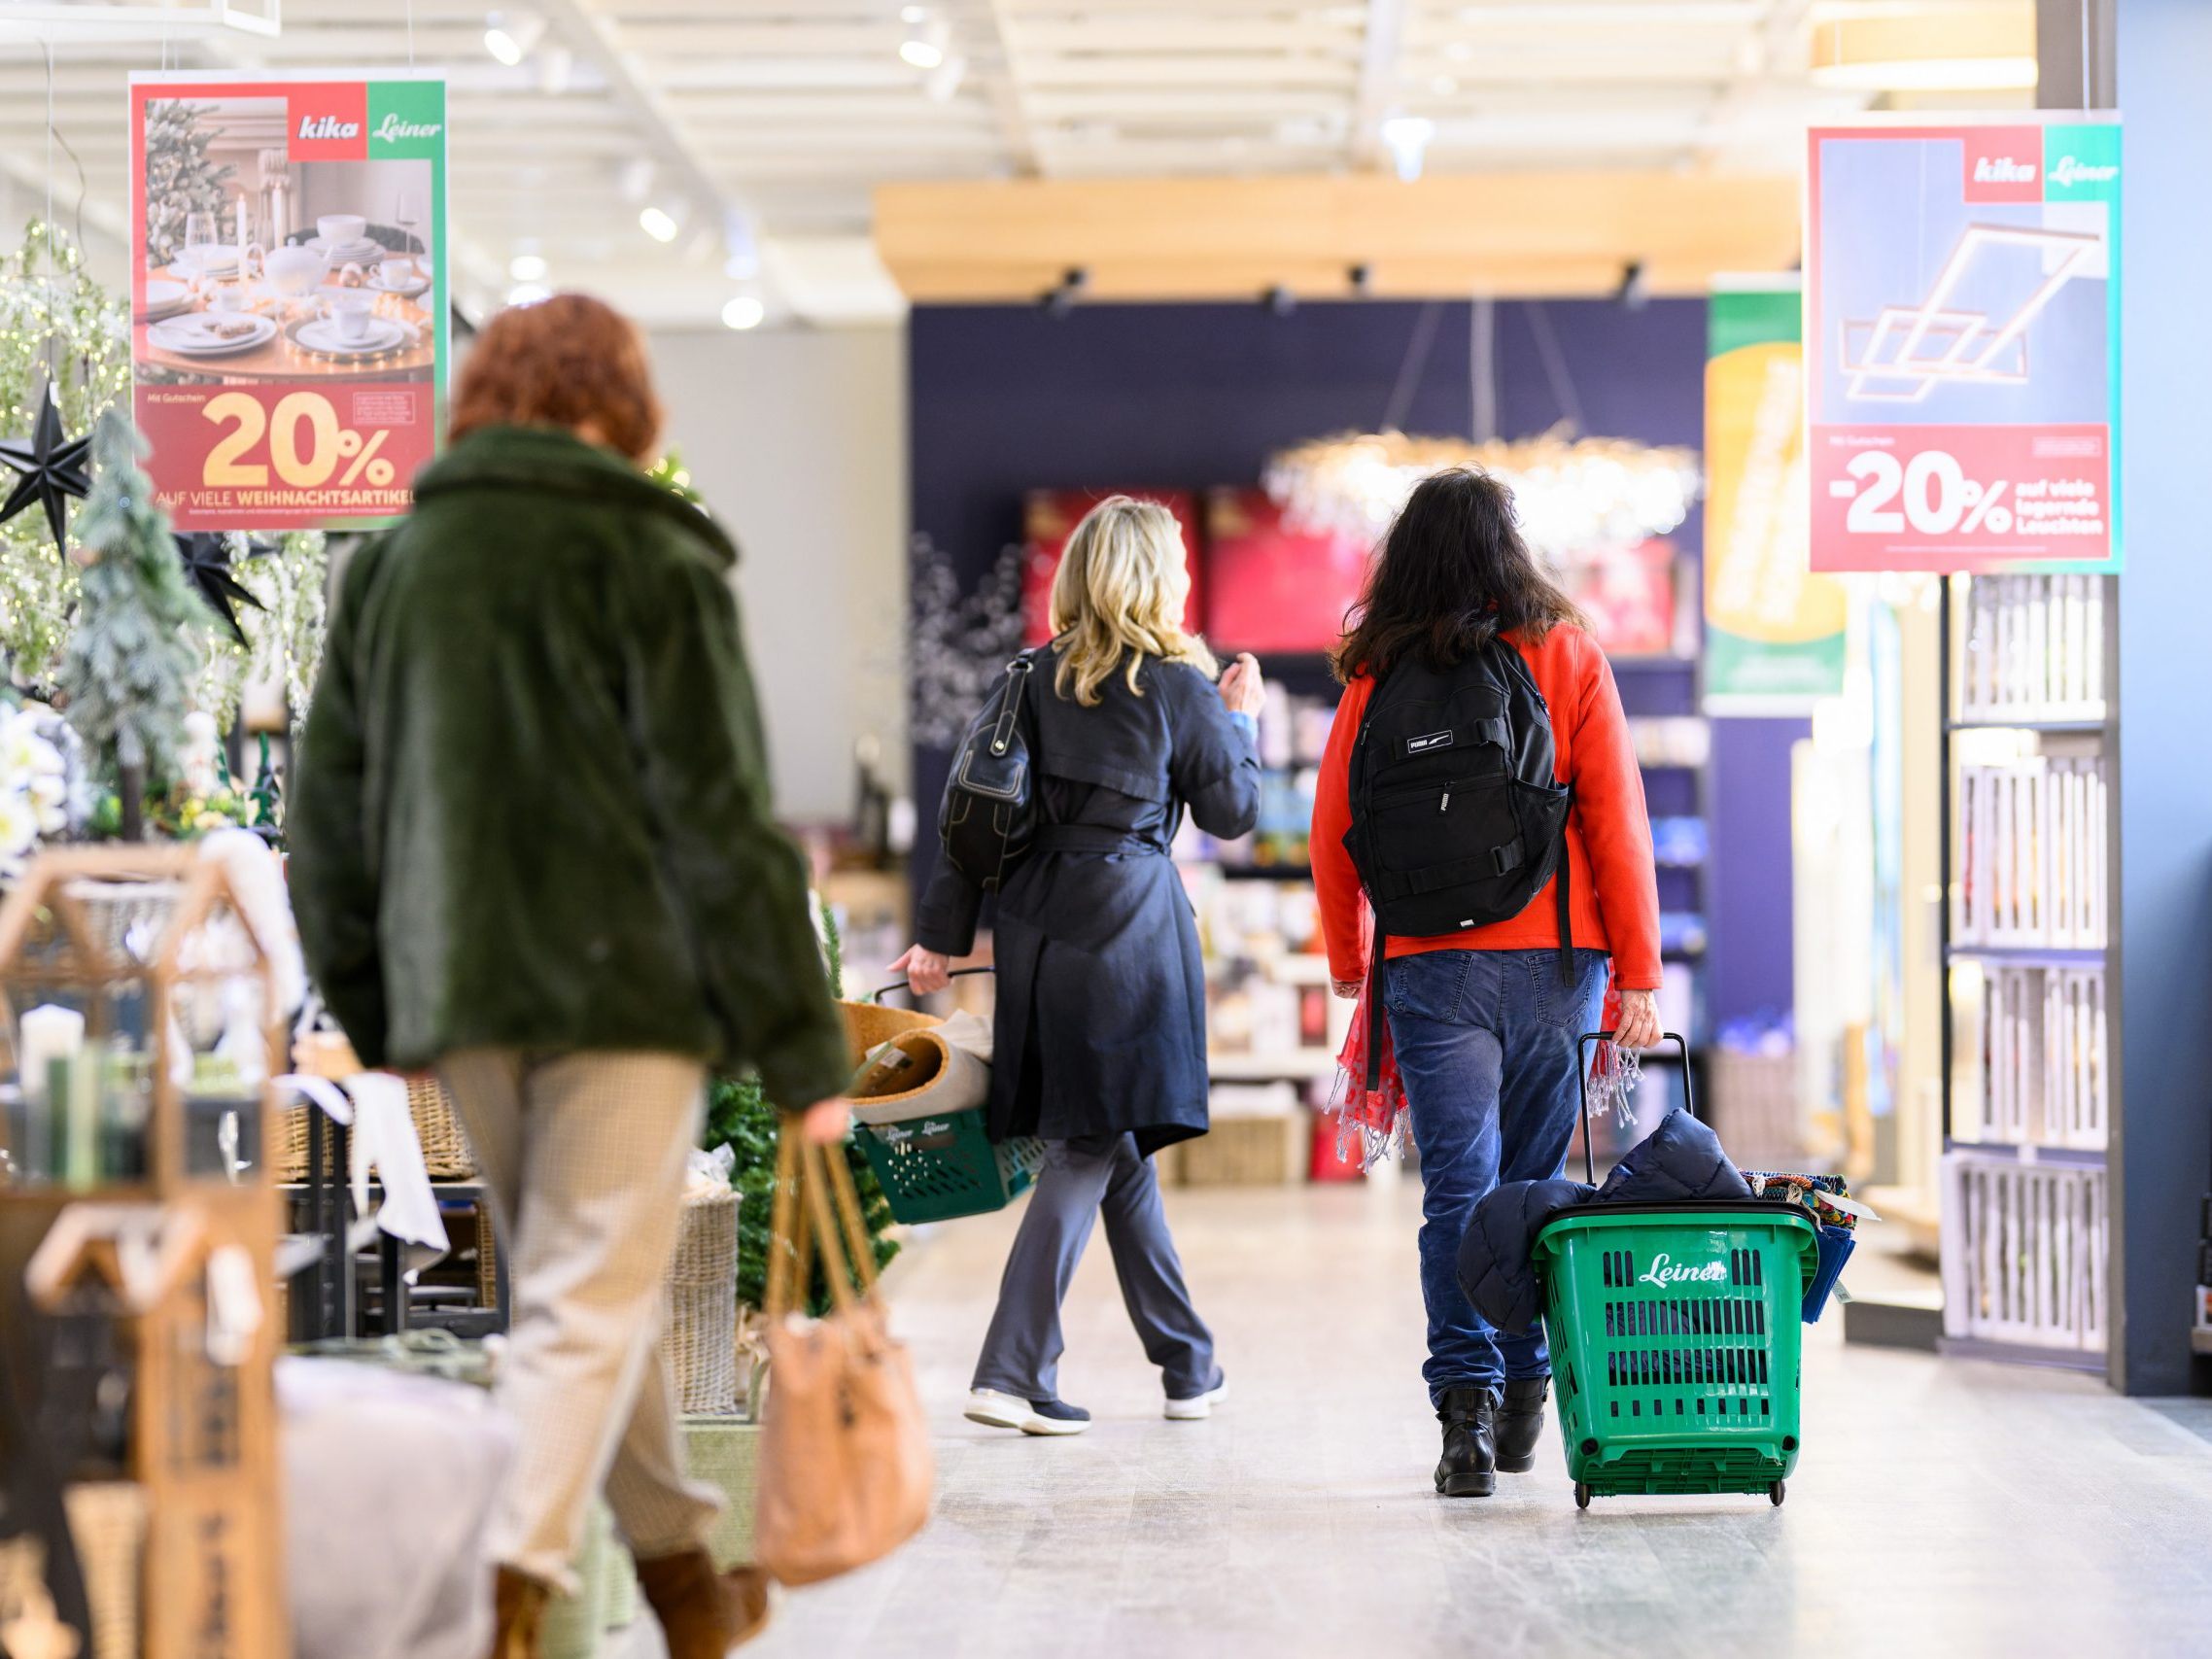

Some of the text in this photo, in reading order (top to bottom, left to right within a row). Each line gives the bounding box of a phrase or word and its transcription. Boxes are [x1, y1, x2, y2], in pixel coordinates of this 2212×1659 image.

[297, 113, 442, 144] kika Leiner
[1974, 155, 2120, 188] kika Leiner
[201, 391, 396, 488] 20%
[156, 491, 187, 506] AUF
[190, 491, 232, 506] VIELE
[1828, 450, 2014, 535] -20%
[2015, 478, 2096, 498] auf viele
